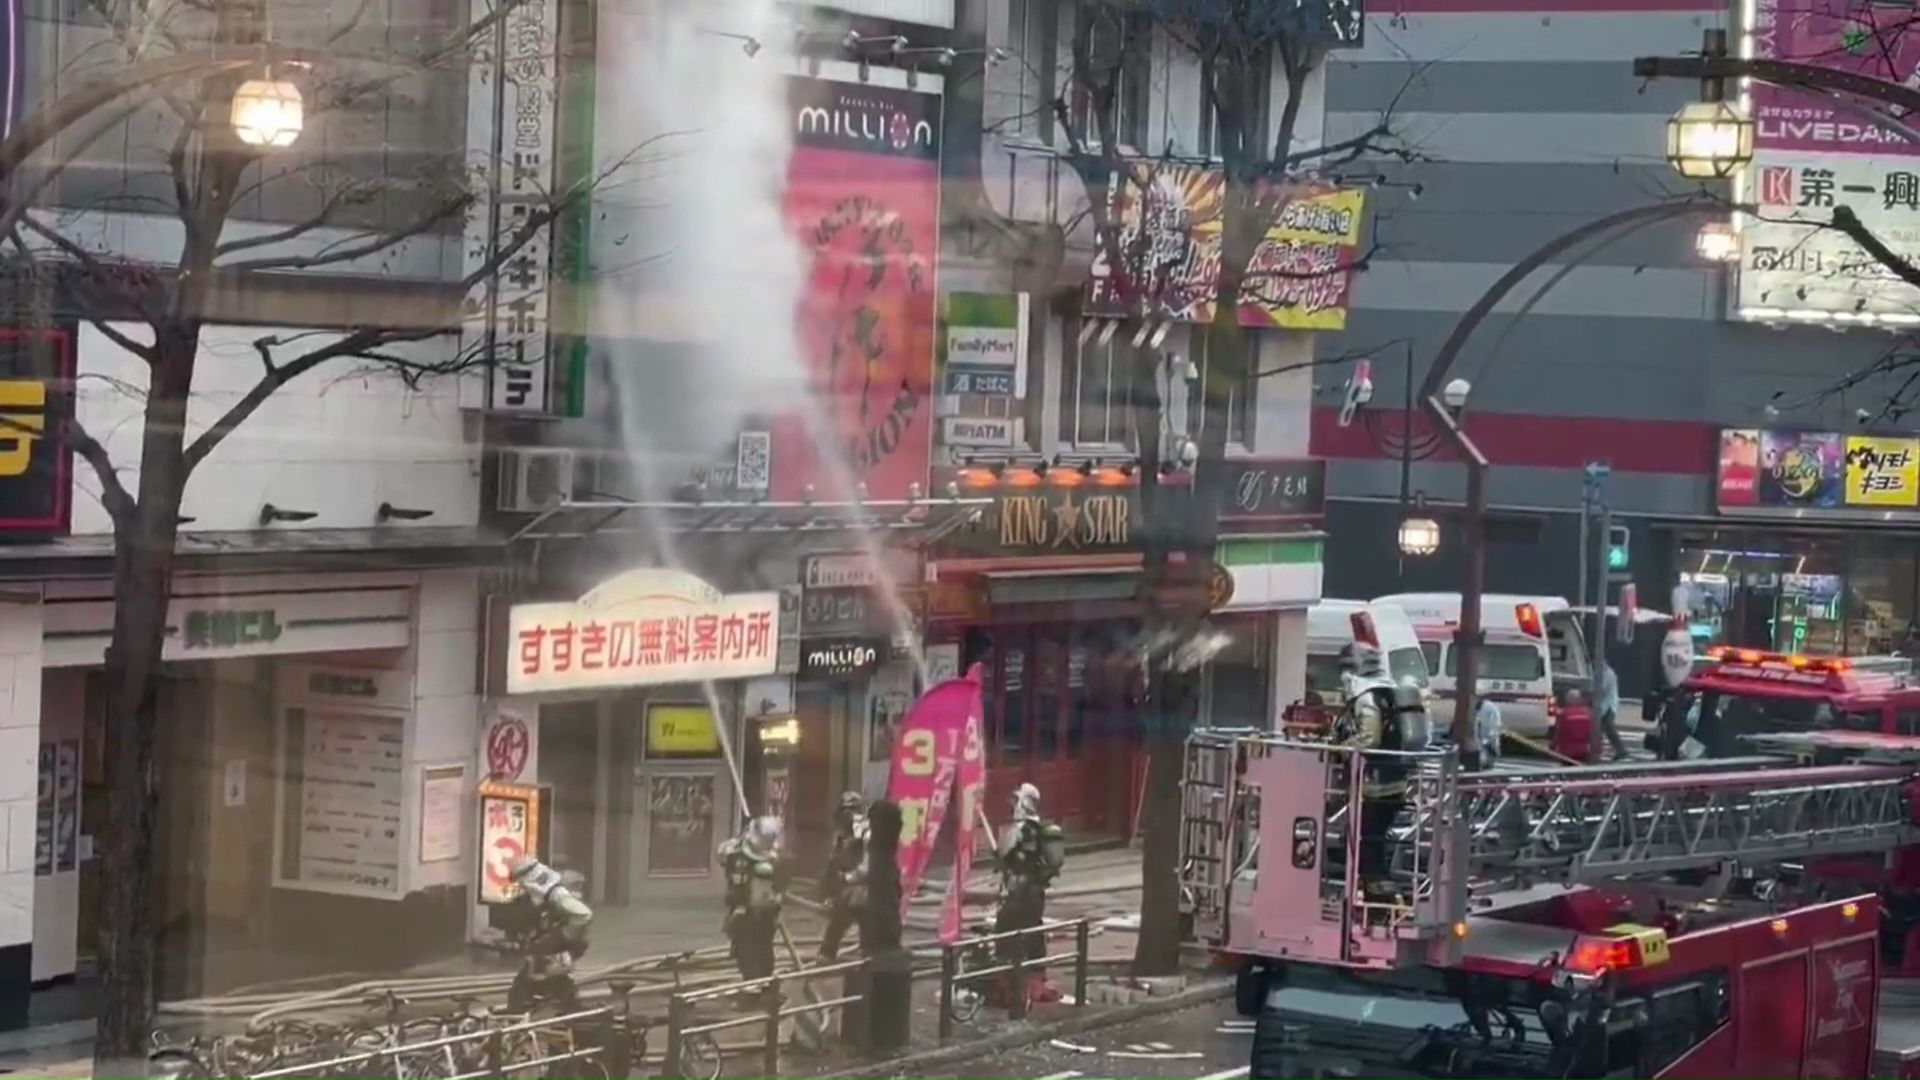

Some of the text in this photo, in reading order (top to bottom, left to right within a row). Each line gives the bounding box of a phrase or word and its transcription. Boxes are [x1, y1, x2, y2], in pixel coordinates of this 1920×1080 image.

[950, 337, 1014, 355] FamilyMart
[1000, 496, 1129, 545] KING STAR
[518, 610, 772, 676] すすきの無料案内所
